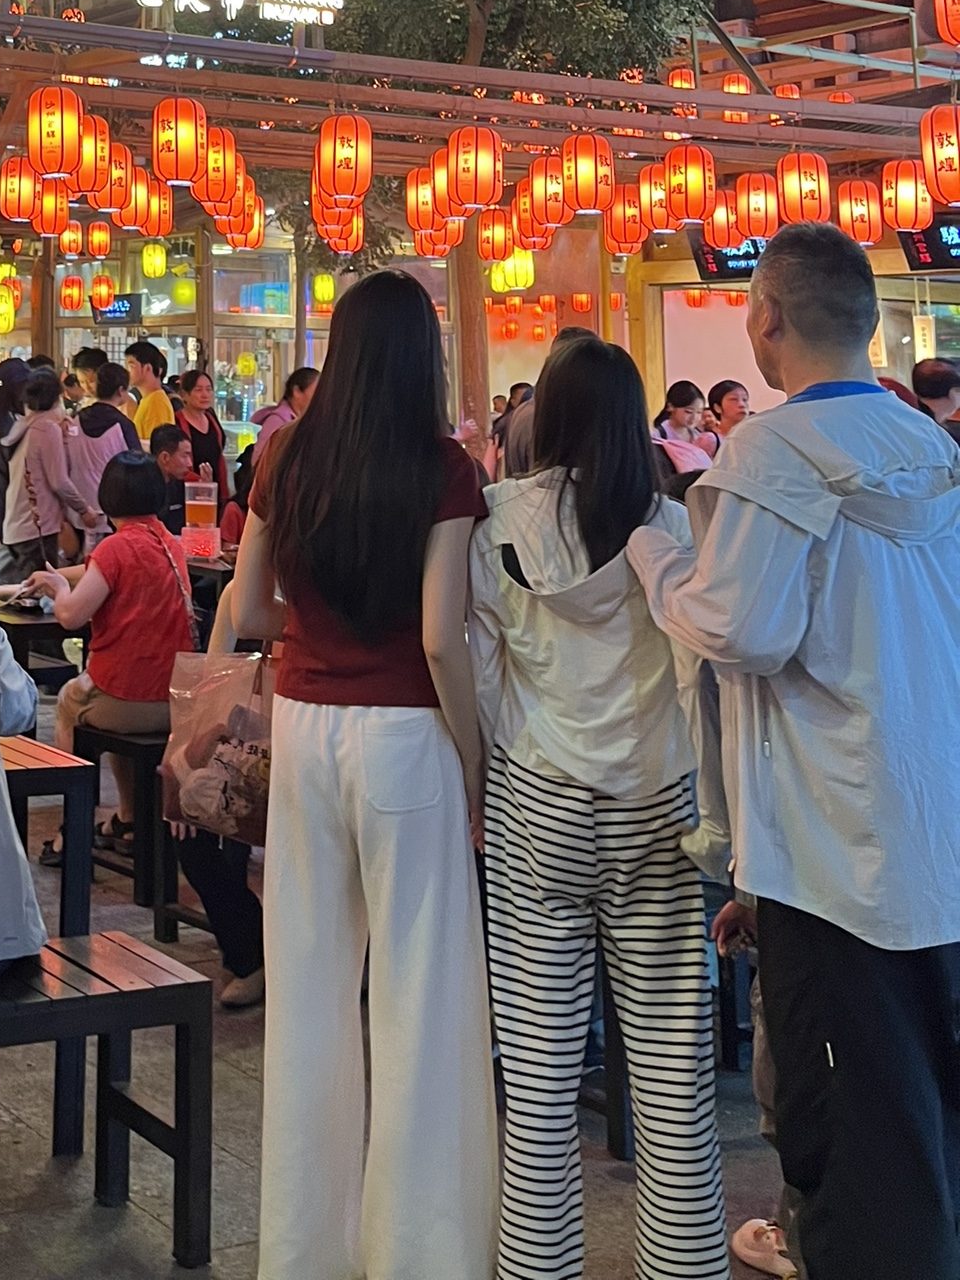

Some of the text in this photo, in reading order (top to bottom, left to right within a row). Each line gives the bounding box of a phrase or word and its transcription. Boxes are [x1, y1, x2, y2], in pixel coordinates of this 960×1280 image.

[159, 118, 174, 154] 敦煌
[337, 136, 354, 171] 敦煌
[935, 132, 957, 172] 敦煌
[112, 158, 125, 189] 敦煌
[598, 154, 611, 187] 敦煌
[672, 164, 685, 195] 敦煌
[802, 170, 818, 201] 敦煌
[548, 174, 561, 204] 敦煌
[853, 197, 867, 224] 敦煌
